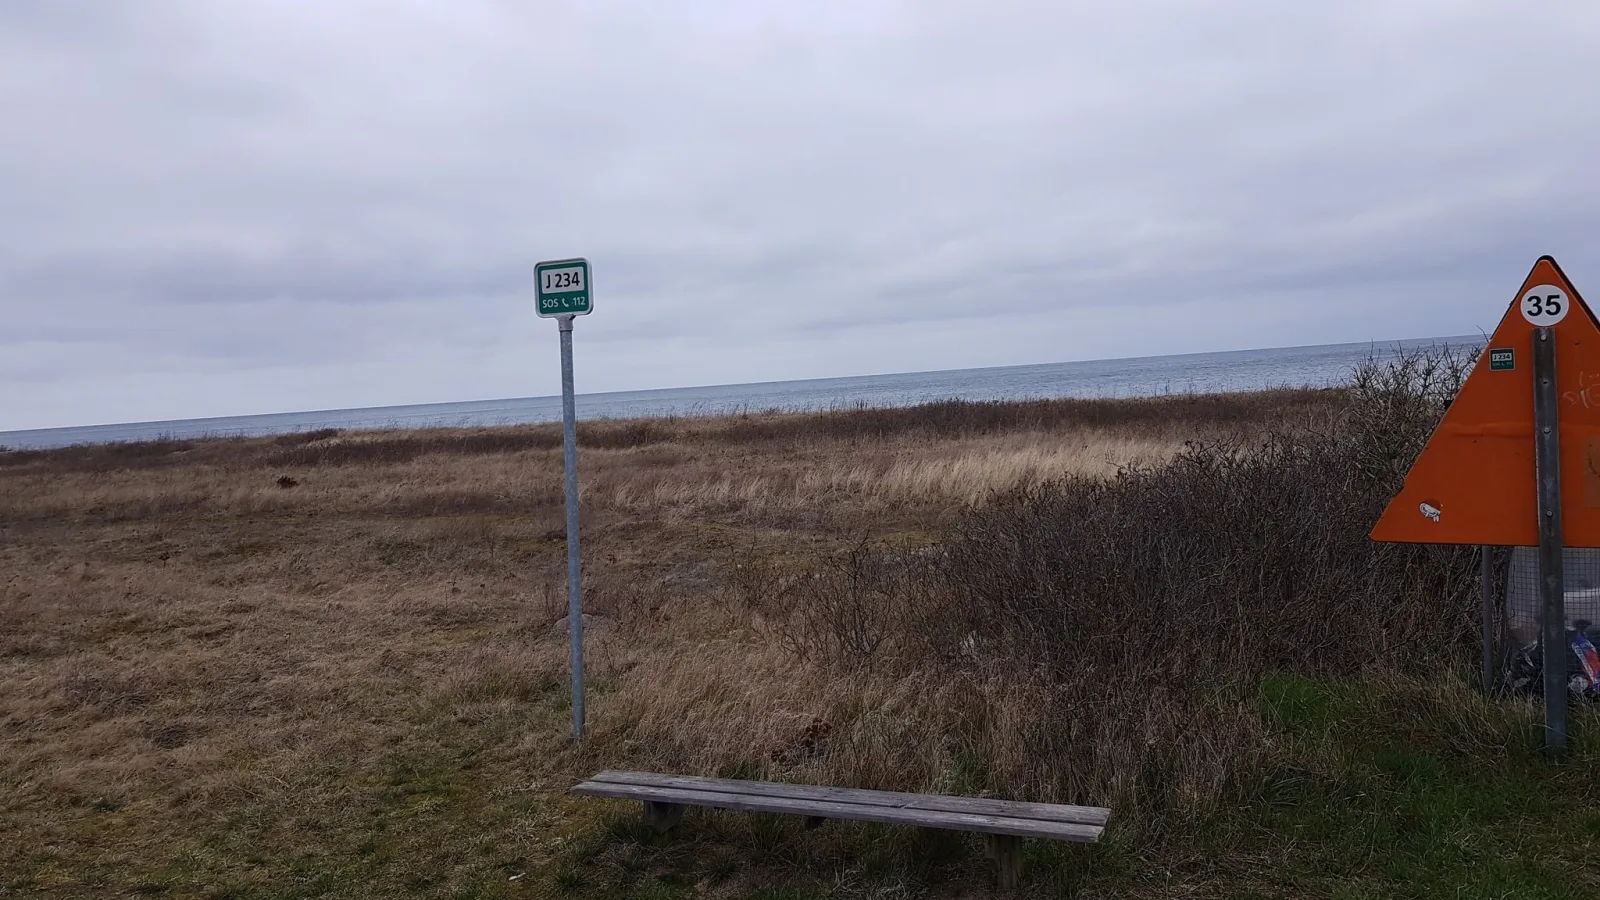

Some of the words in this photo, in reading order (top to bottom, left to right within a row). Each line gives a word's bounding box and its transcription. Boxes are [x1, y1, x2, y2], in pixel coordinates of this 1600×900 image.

[546, 274, 551, 288] J
[554, 272, 580, 288] 234
[542, 298, 558, 308] SOS
[572, 296, 586, 306] 112
[1526, 294, 1562, 316] 35
